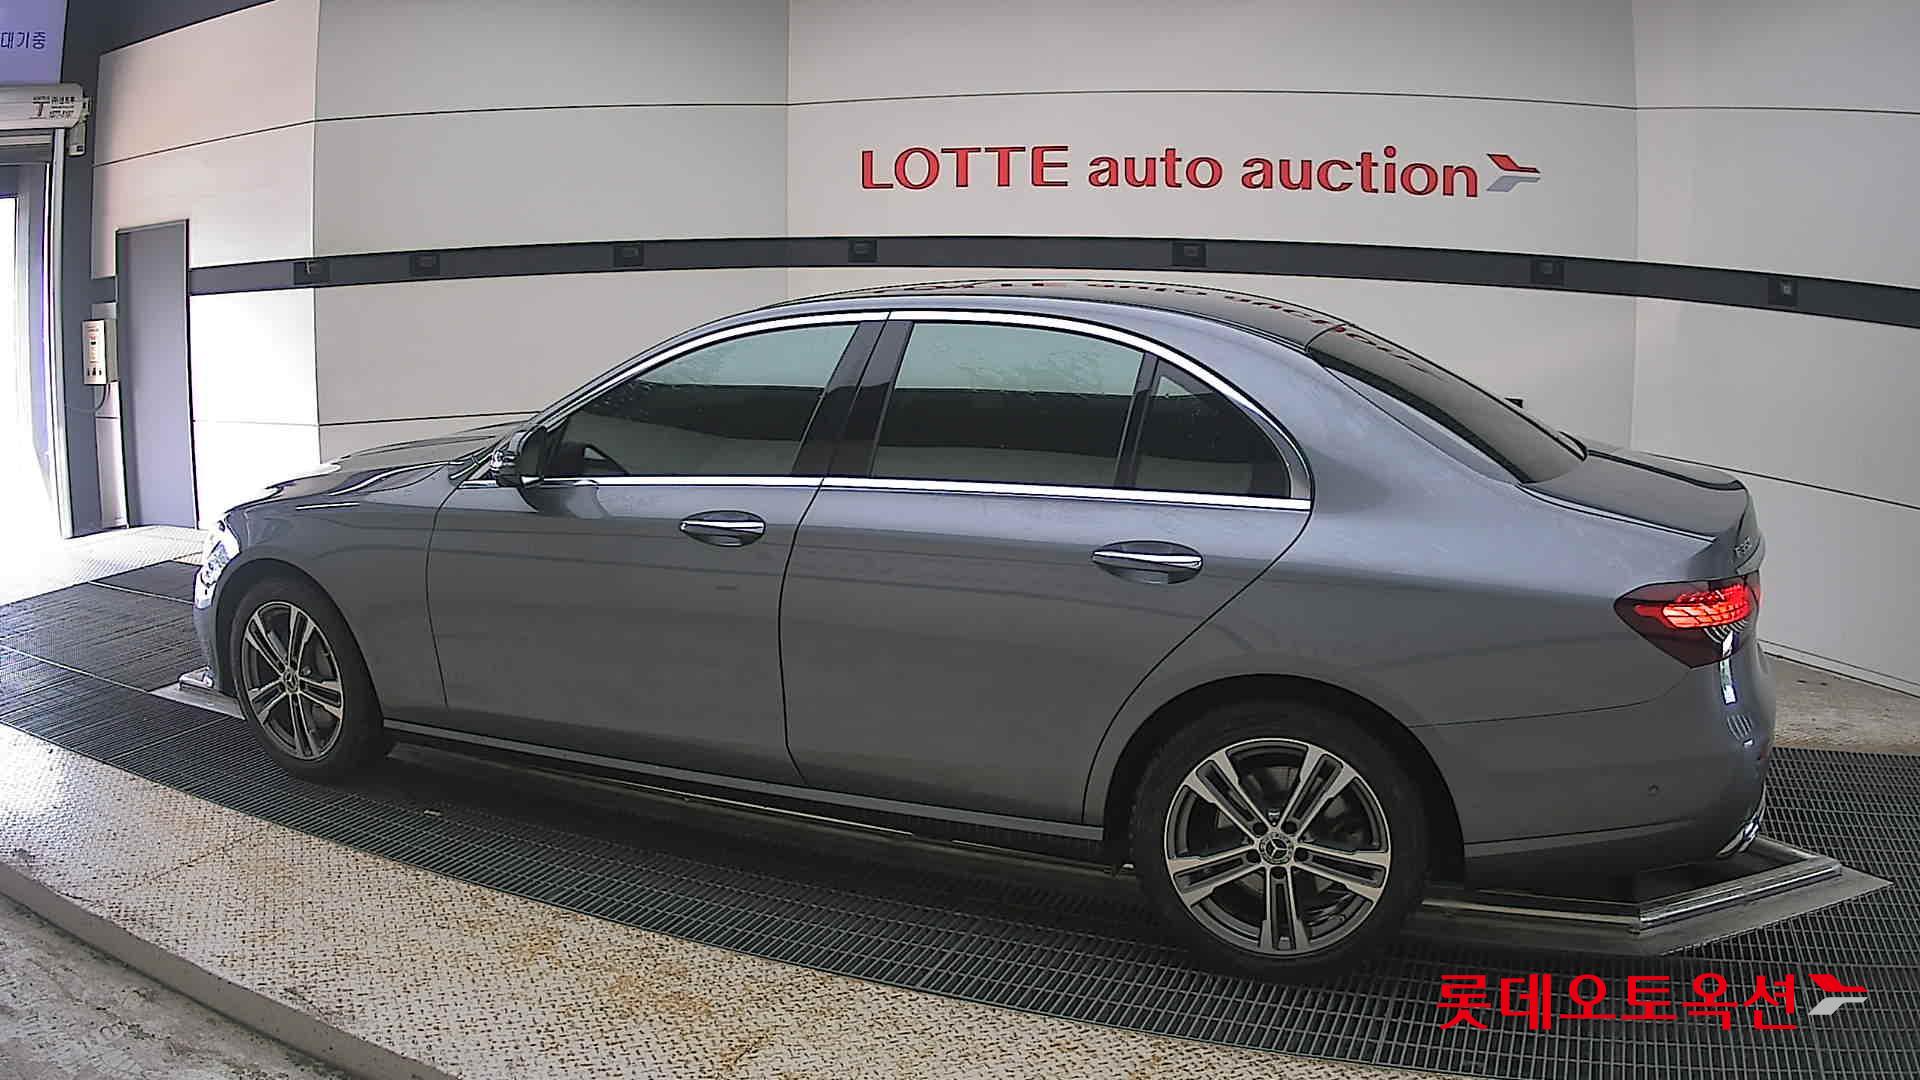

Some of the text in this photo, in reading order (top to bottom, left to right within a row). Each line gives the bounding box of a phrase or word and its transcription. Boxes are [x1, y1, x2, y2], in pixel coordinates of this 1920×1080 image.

[861, 145, 1480, 198] LOTTE auto auction
